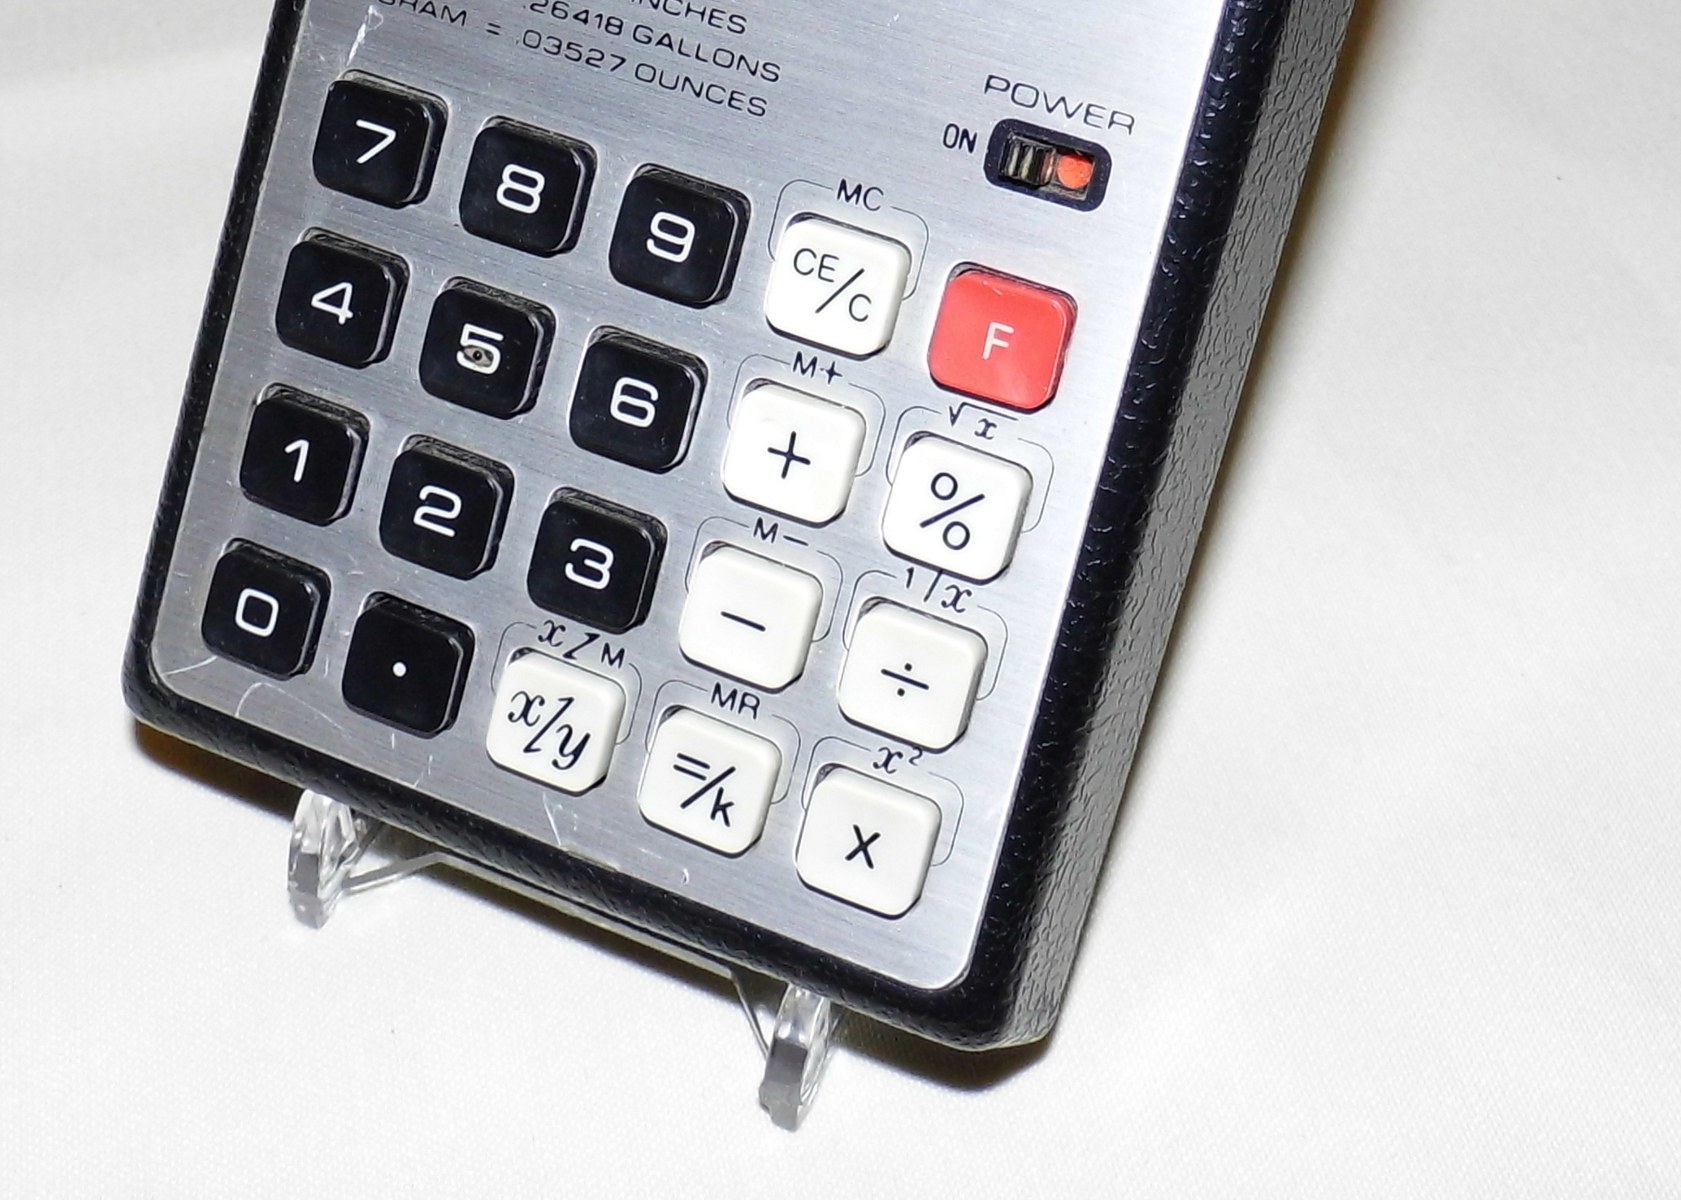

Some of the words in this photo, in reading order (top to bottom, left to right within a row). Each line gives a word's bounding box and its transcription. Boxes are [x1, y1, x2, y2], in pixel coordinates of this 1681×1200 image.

[632, 24, 782, 83] GALLONS
[634, 62, 768, 117] OUNCES
[983, 74, 1136, 135] POWER
[354, 117, 397, 165] 7
[942, 123, 978, 155] ON
[495, 163, 546, 215] 8
[836, 178, 885, 212] MC
[645, 211, 696, 263] 9
[310, 281, 354, 326] 4
[455, 323, 504, 376] 5
[980, 321, 1015, 360] F
[792, 350, 844, 384] M+
[608, 376, 659, 429] 6
[283, 439, 311, 482] 1
[412, 484, 463, 538] 2
[918, 471, 987, 552] %
[564, 537, 615, 591] 3
[710, 682, 761, 719] MR
